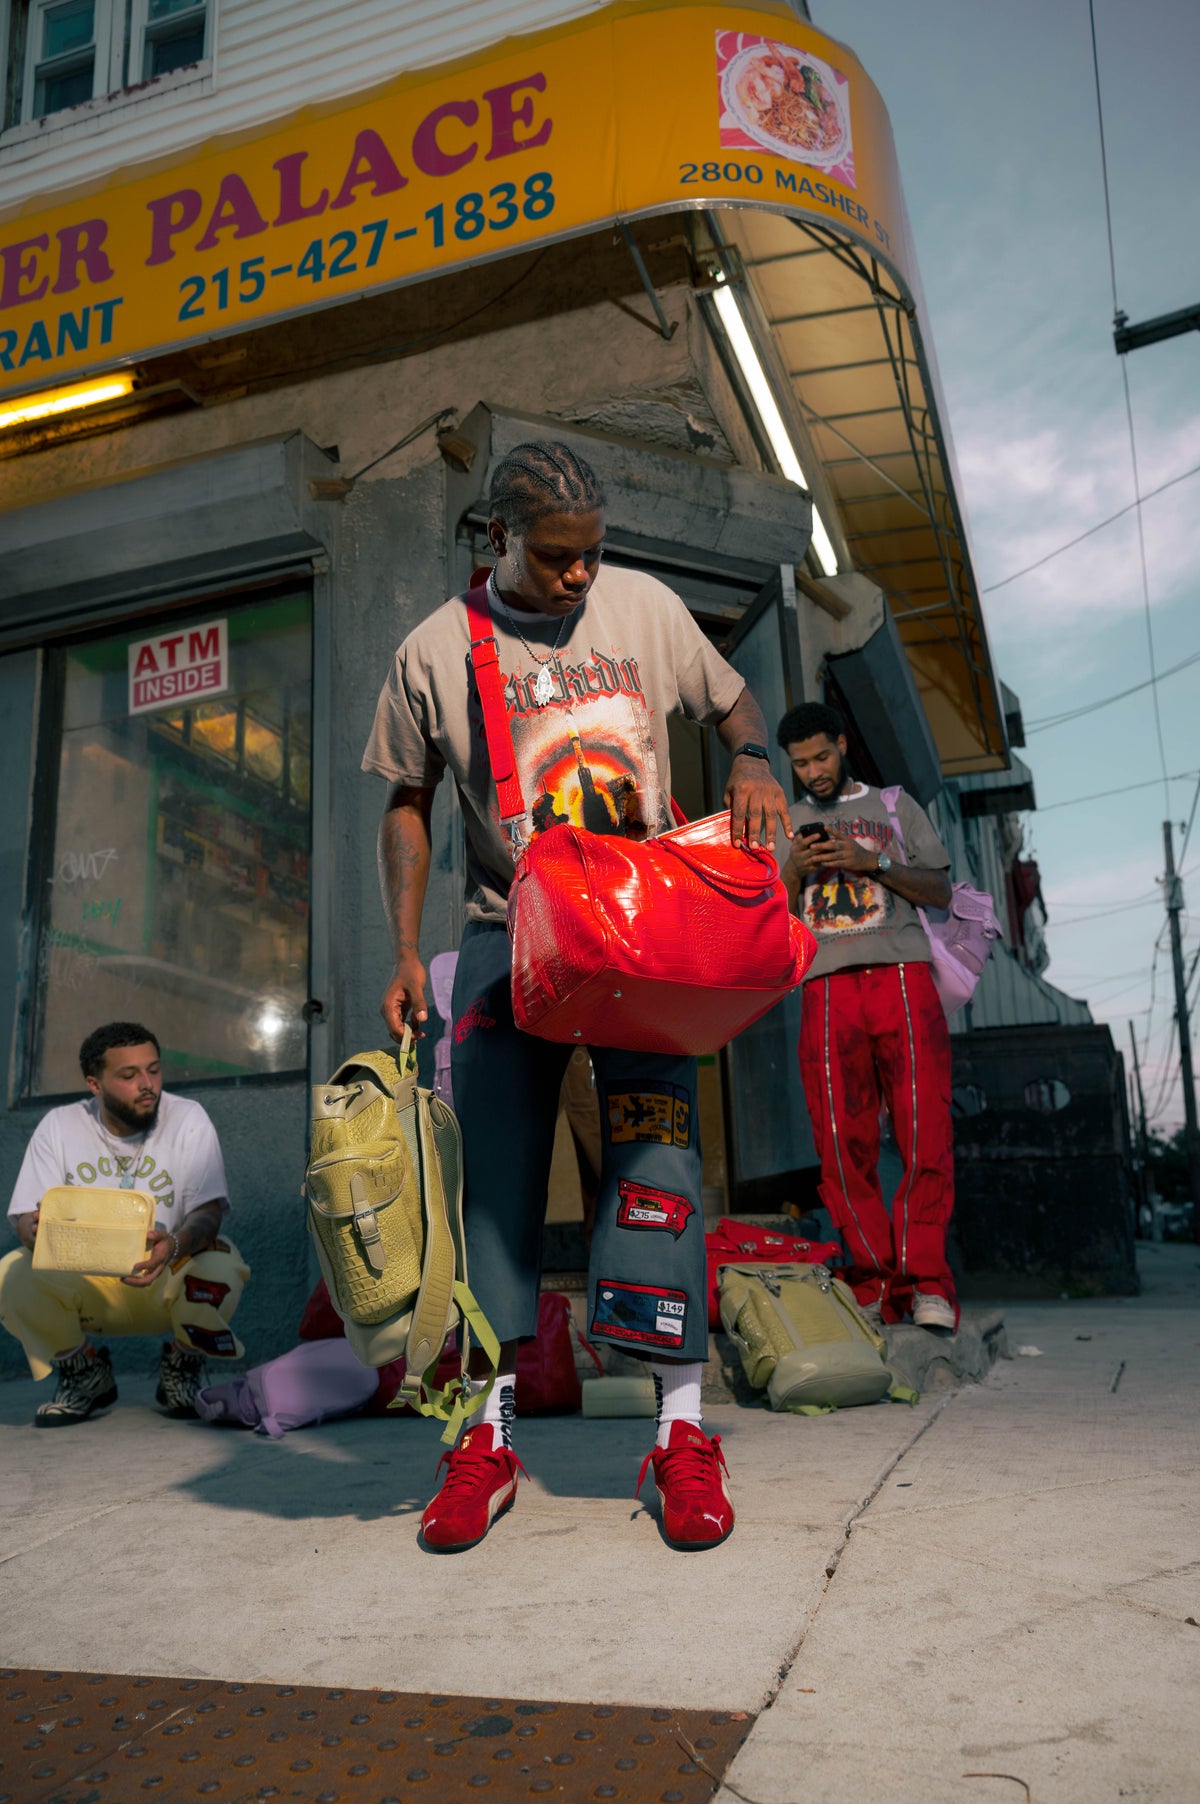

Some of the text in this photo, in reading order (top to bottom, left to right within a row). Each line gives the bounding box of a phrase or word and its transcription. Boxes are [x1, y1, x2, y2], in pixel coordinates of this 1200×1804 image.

[0, 71, 554, 311] ER PALACE
[679, 162, 763, 185] 2800
[775, 169, 870, 230] MASHER
[177, 171, 556, 323] 215-427-1838
[133, 627, 219, 678] ATM
[140, 664, 215, 702] INSIDE
[629, 1210, 650, 1220] $275
[658, 1301, 683, 1314] $149
